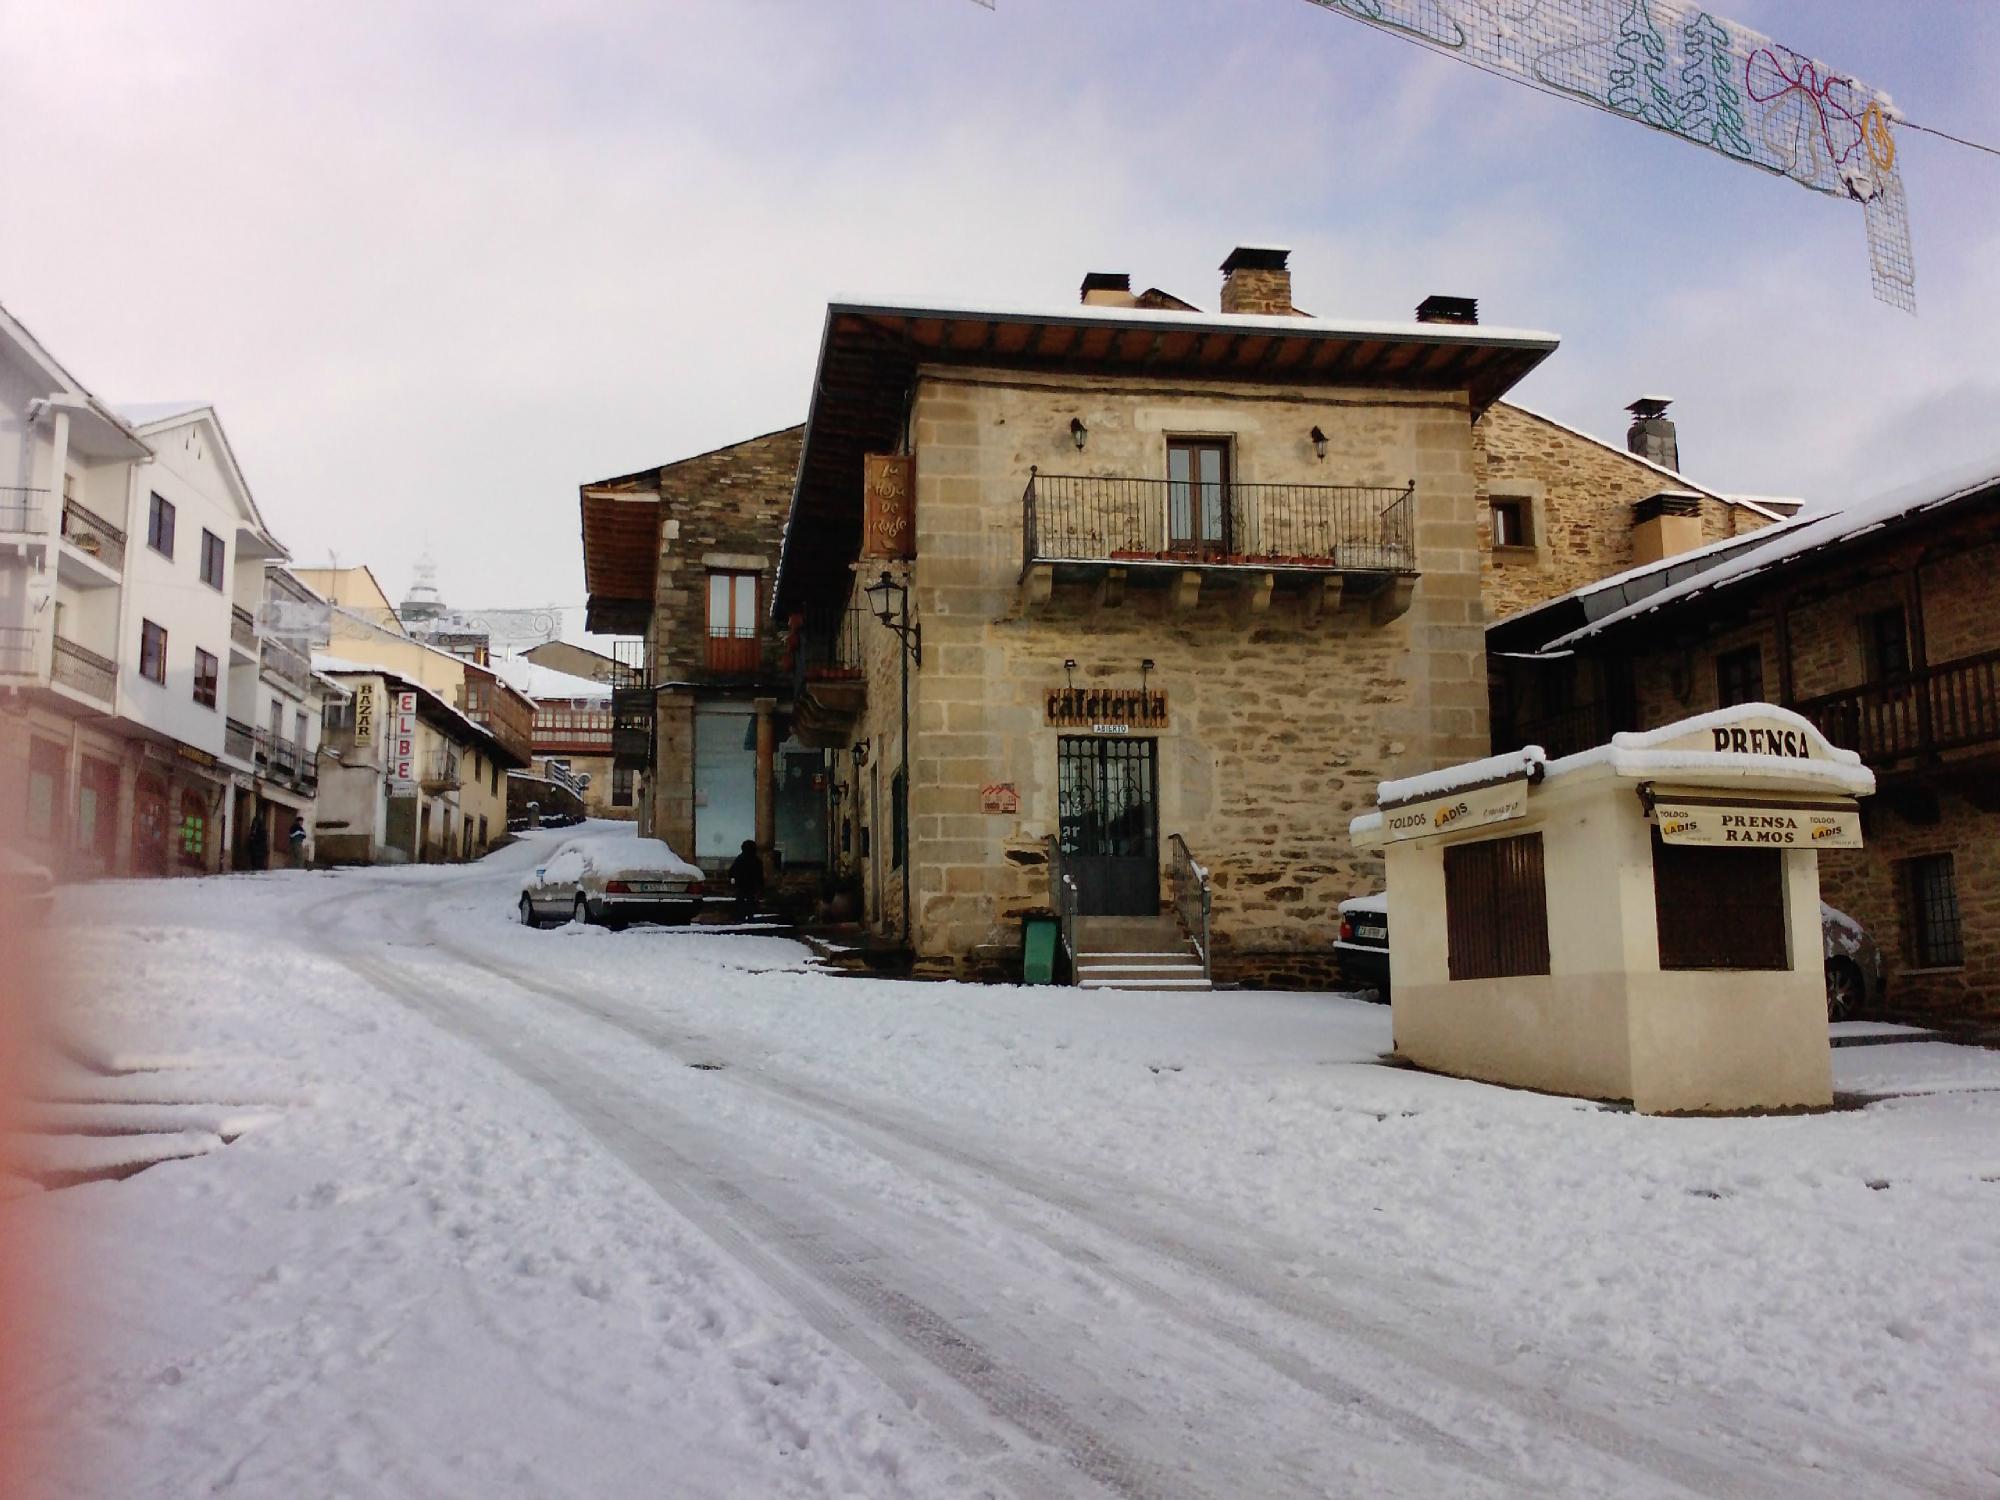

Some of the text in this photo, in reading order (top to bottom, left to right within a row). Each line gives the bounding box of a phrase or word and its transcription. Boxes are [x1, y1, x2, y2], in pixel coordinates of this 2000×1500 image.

[358, 685, 373, 736] BAZAR
[1096, 725, 1127, 733] ABIERTO
[398, 695, 412, 779] ELBE
[1712, 727, 1810, 759] PRENSA
[1388, 813, 1427, 830] TOLDOS
[1434, 802, 1468, 828] LADIS
[1721, 815, 1798, 829] PRENSA
[1809, 816, 1836, 824] TOLDOS
[1663, 821, 1698, 835] LADIS
[1811, 826, 1842, 840] LADIS
[1725, 829, 1795, 843] RAMOS
